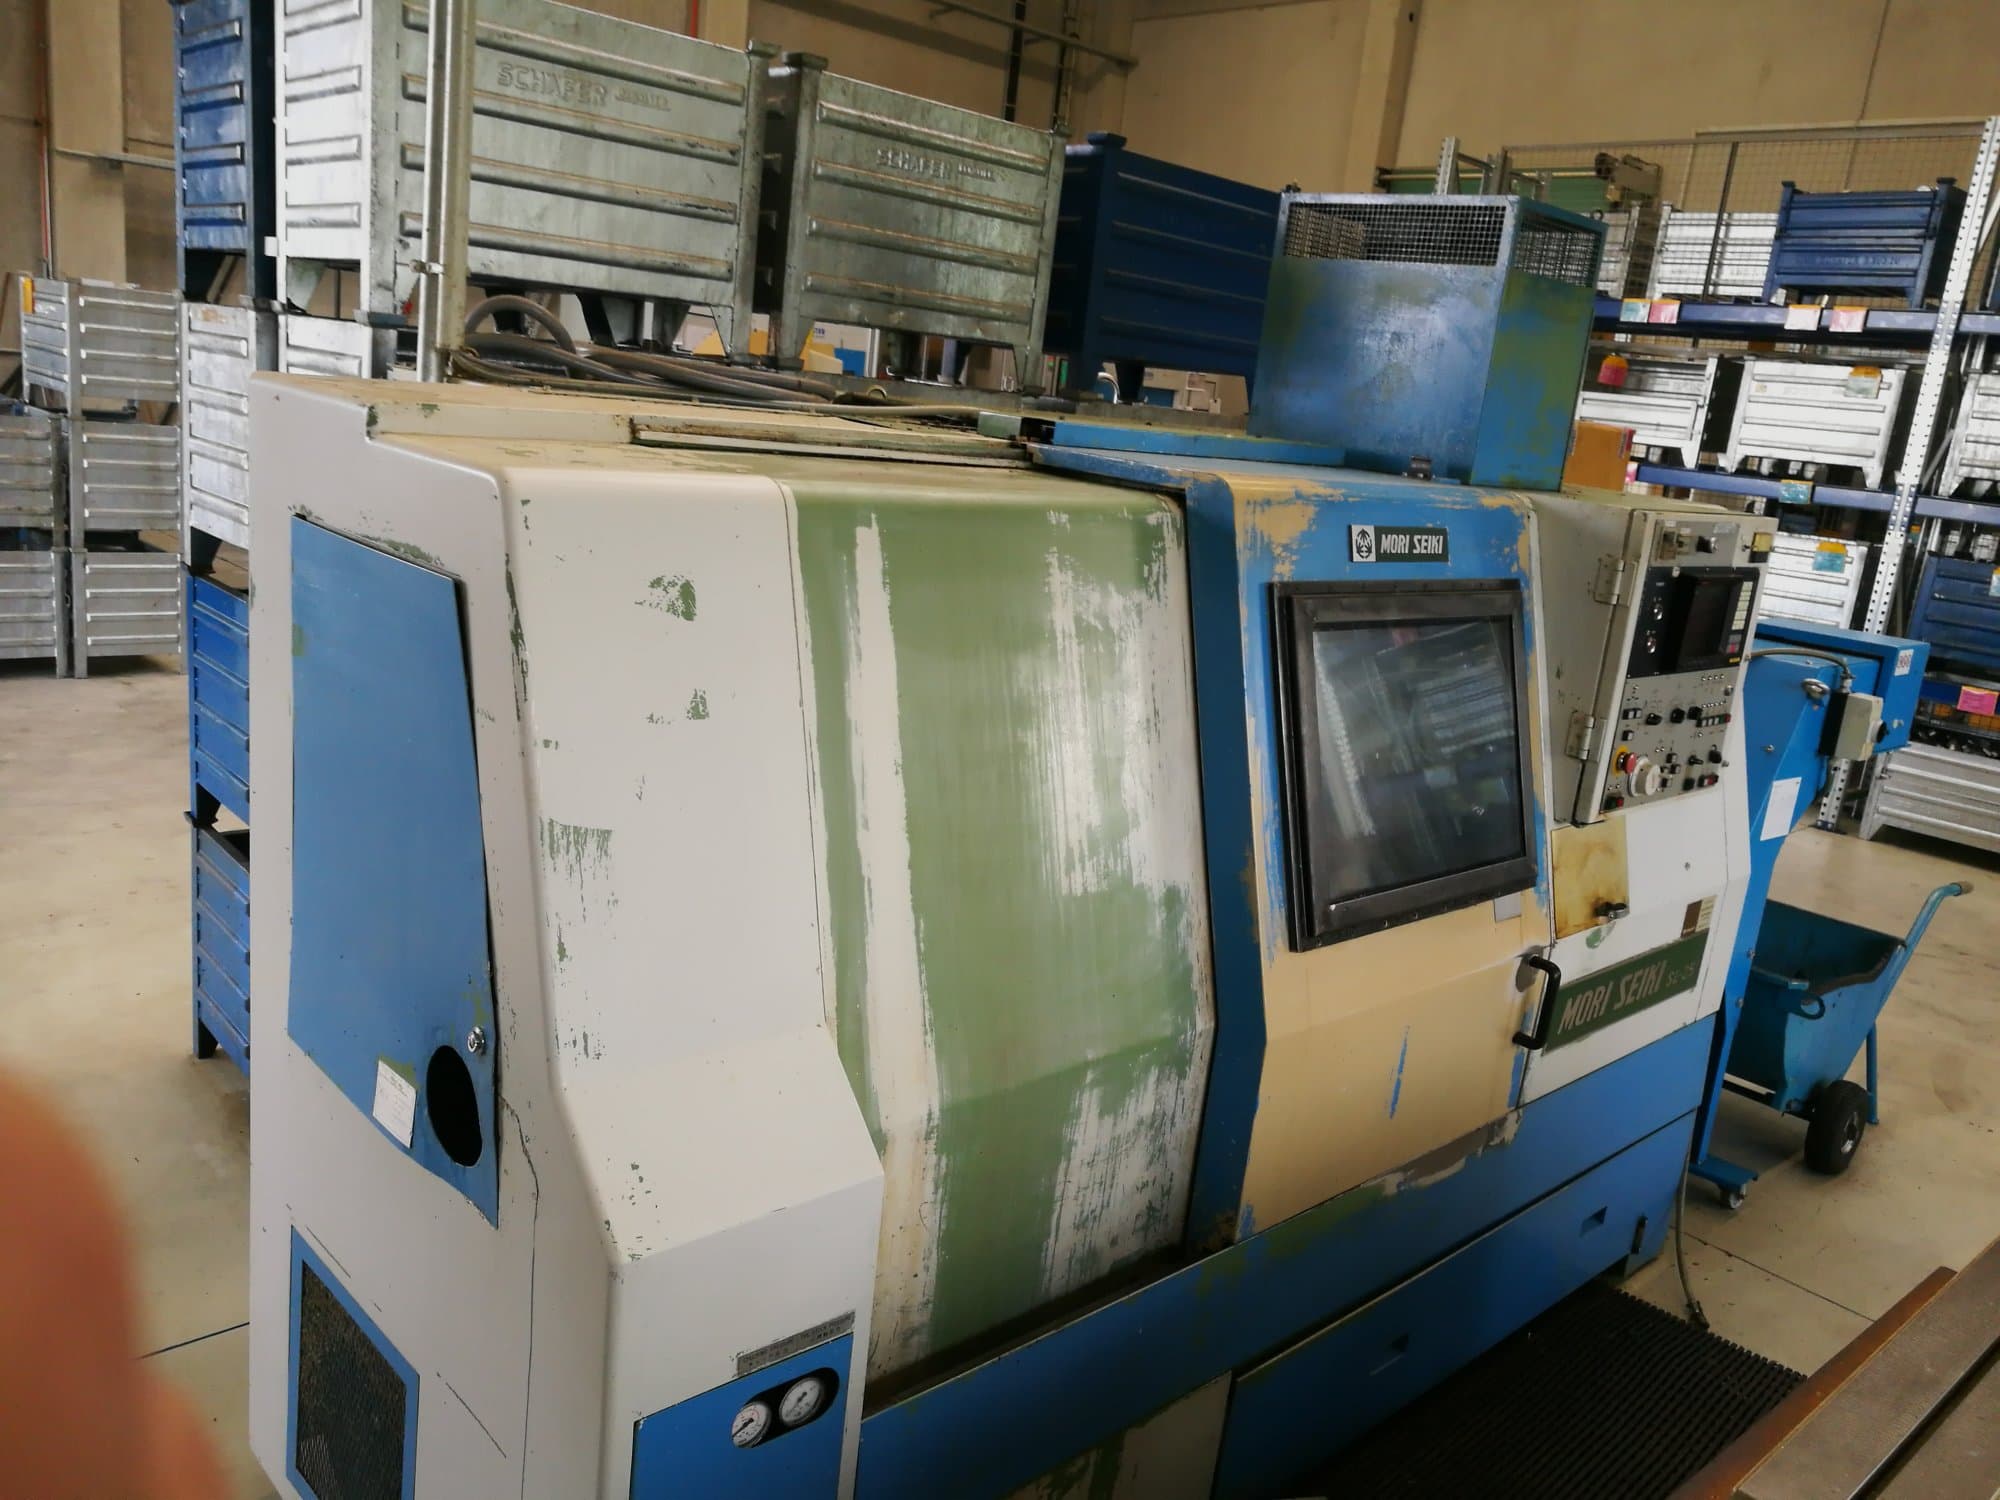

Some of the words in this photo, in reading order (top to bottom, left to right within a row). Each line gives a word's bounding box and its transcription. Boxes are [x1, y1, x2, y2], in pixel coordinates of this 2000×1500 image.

[1382, 534, 1410, 554] MORI
[1413, 535, 1444, 554] SEIKI
[1559, 983, 1614, 1034] MORI
[1614, 961, 1667, 1010] SEIKI
